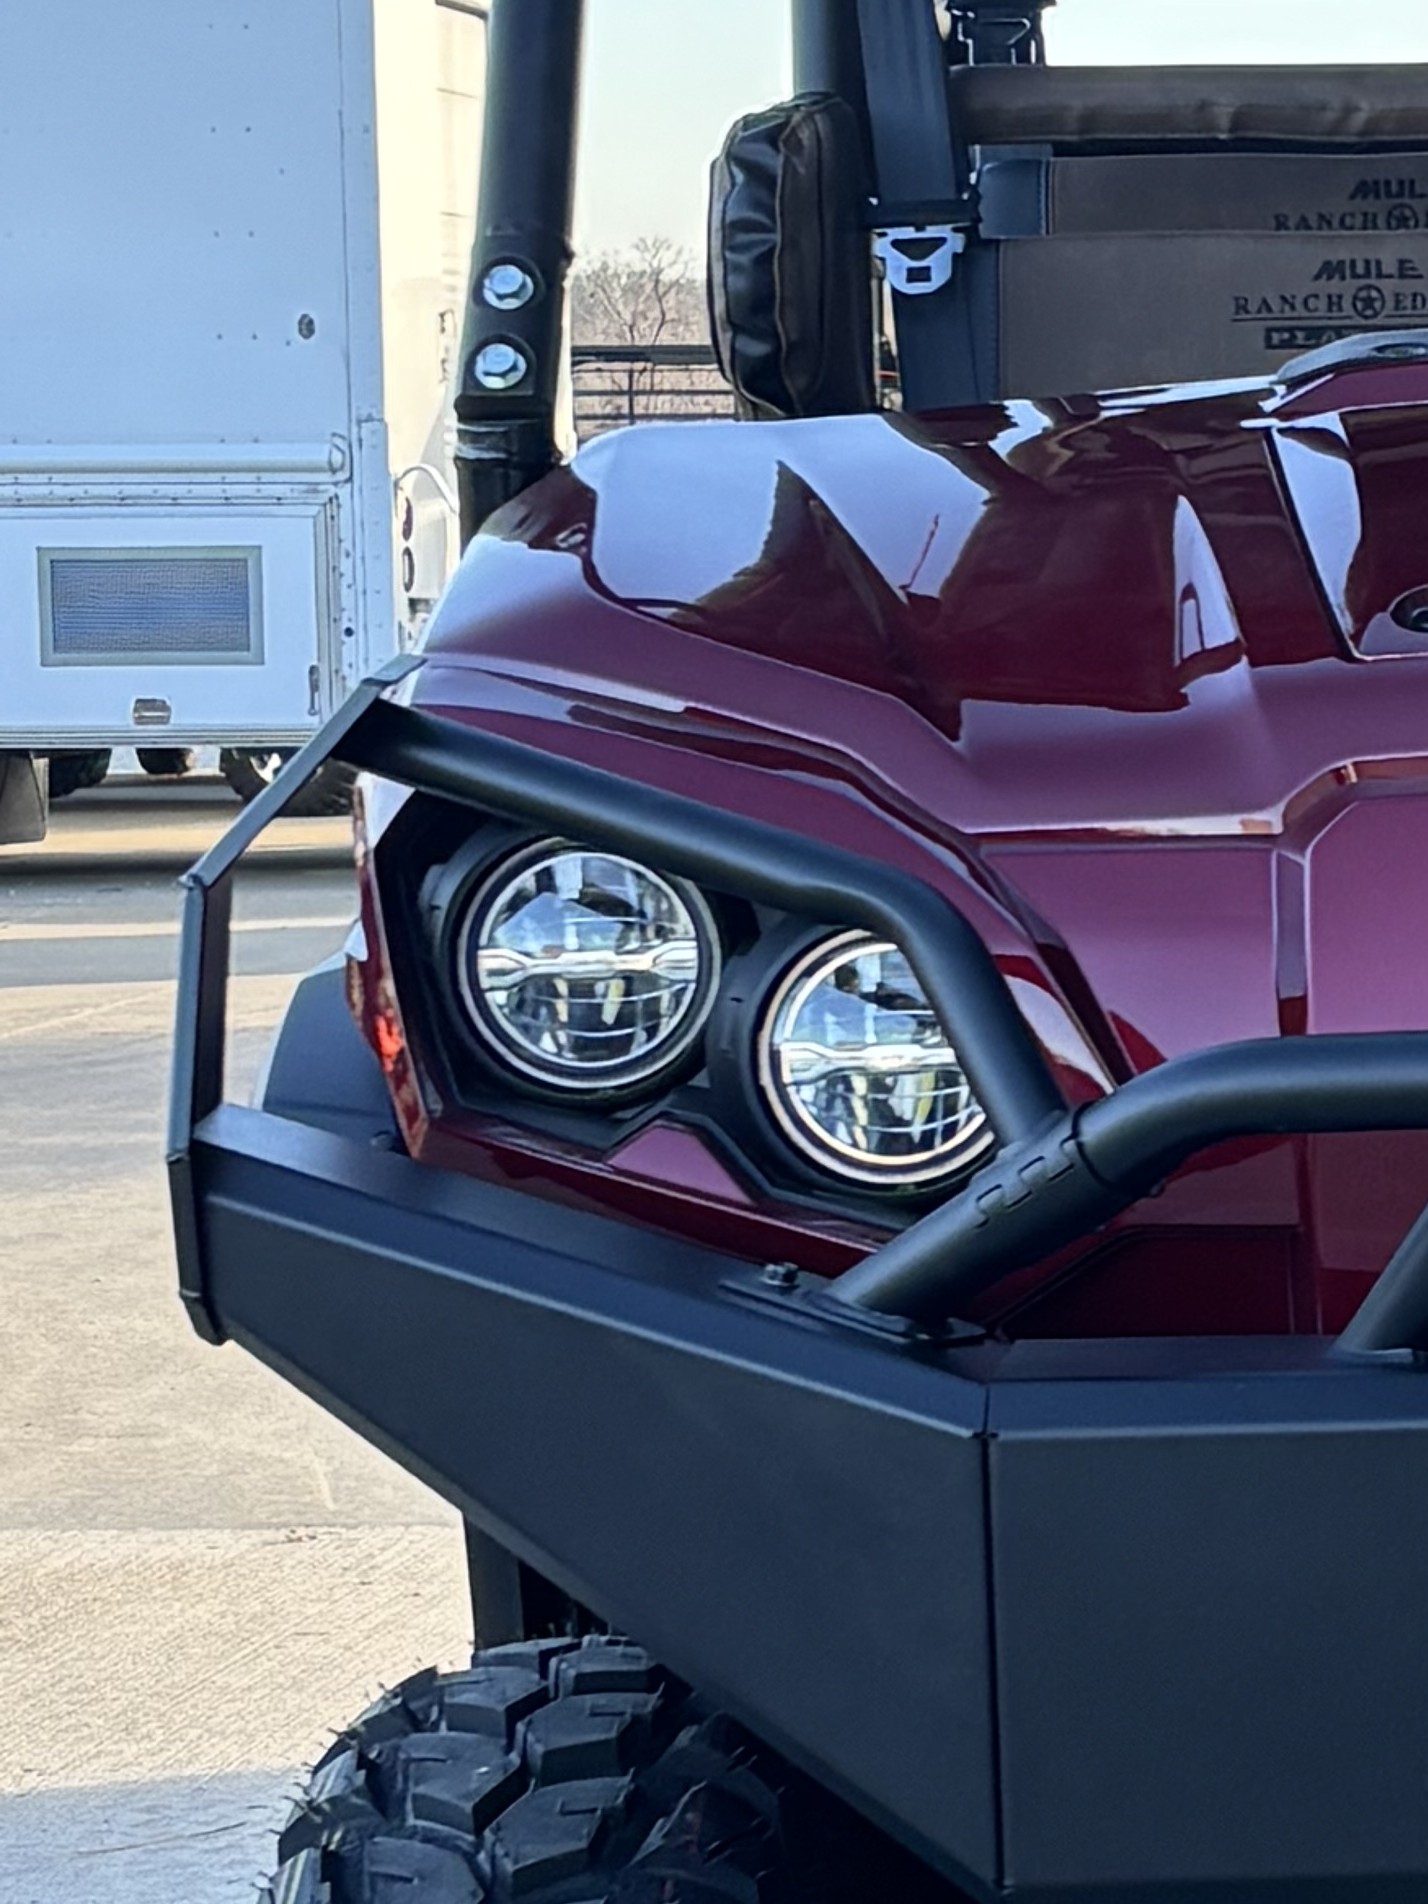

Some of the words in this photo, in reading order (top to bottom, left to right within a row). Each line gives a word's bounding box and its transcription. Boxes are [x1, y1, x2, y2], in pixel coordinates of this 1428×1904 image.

[1273, 212, 1379, 232] RANCH
[1311, 258, 1424, 281] MULE
[1233, 295, 1344, 316] RANCH
